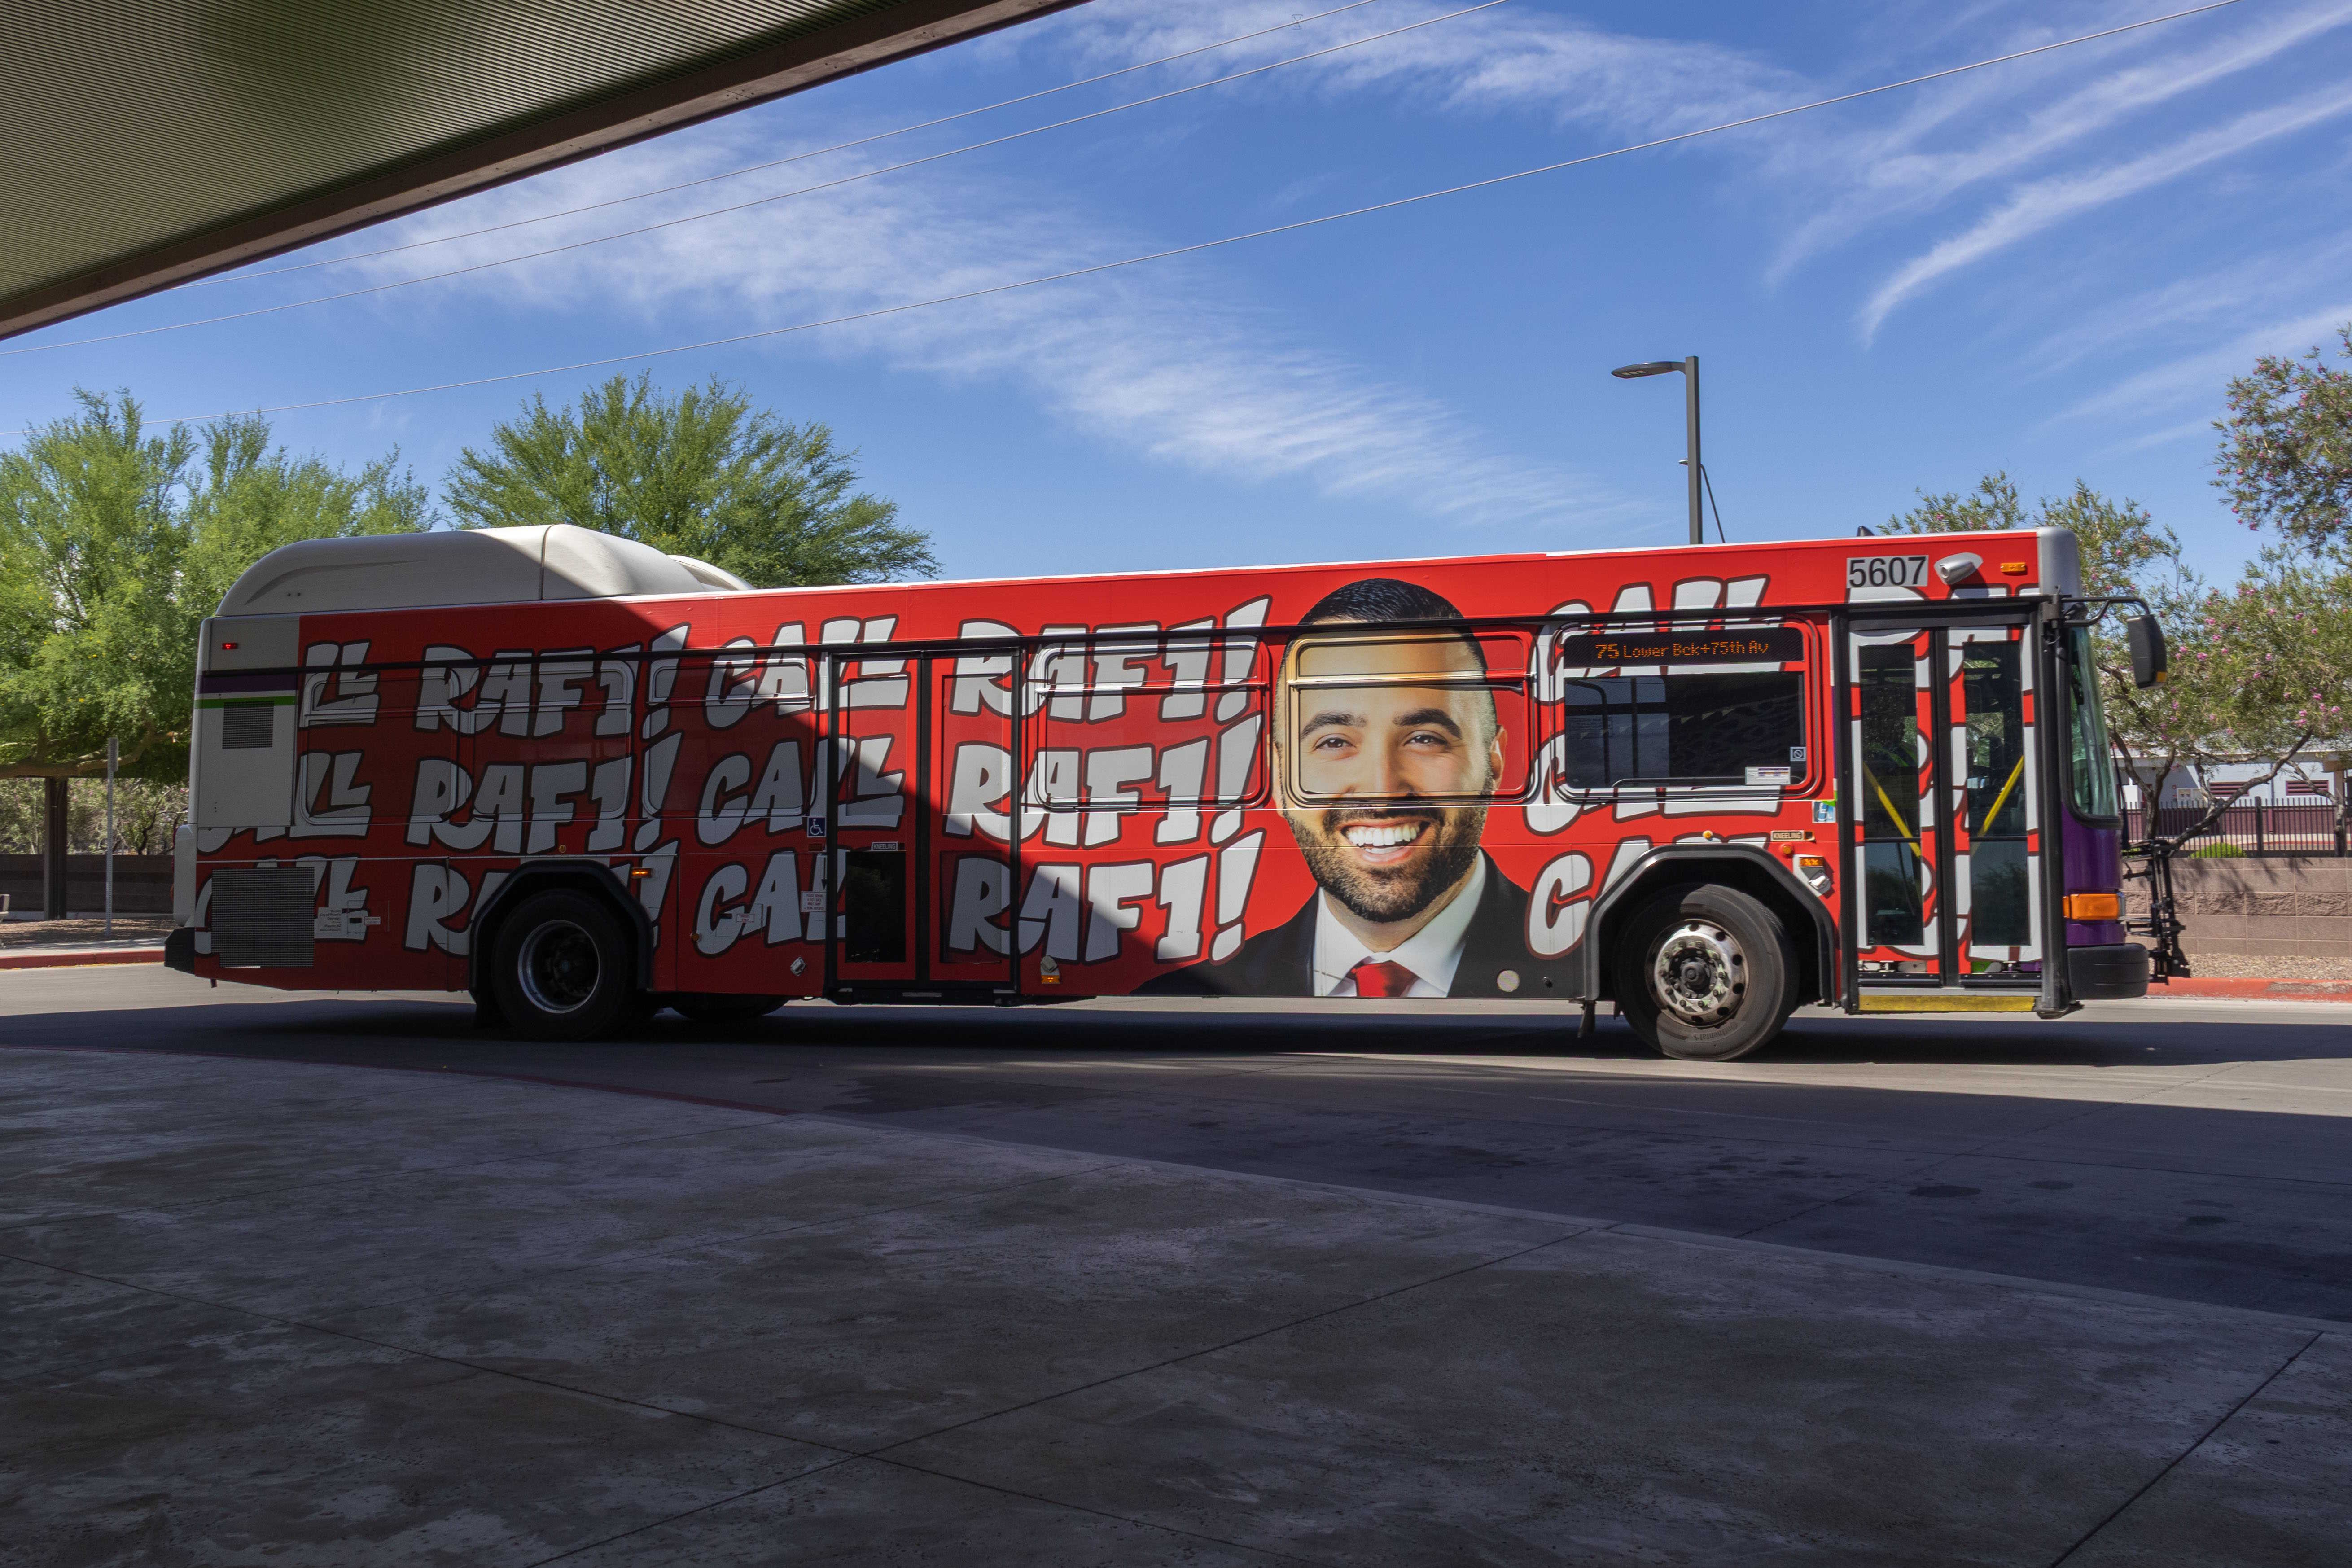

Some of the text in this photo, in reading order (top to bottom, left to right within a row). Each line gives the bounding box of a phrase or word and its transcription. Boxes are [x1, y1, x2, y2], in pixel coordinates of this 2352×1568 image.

[1849, 556, 1927, 587] 5607
[704, 615, 911, 730] CALL
[1595, 640, 1769, 659] 75 Lower Bck+75th Av
[695, 734, 907, 848] CALL
